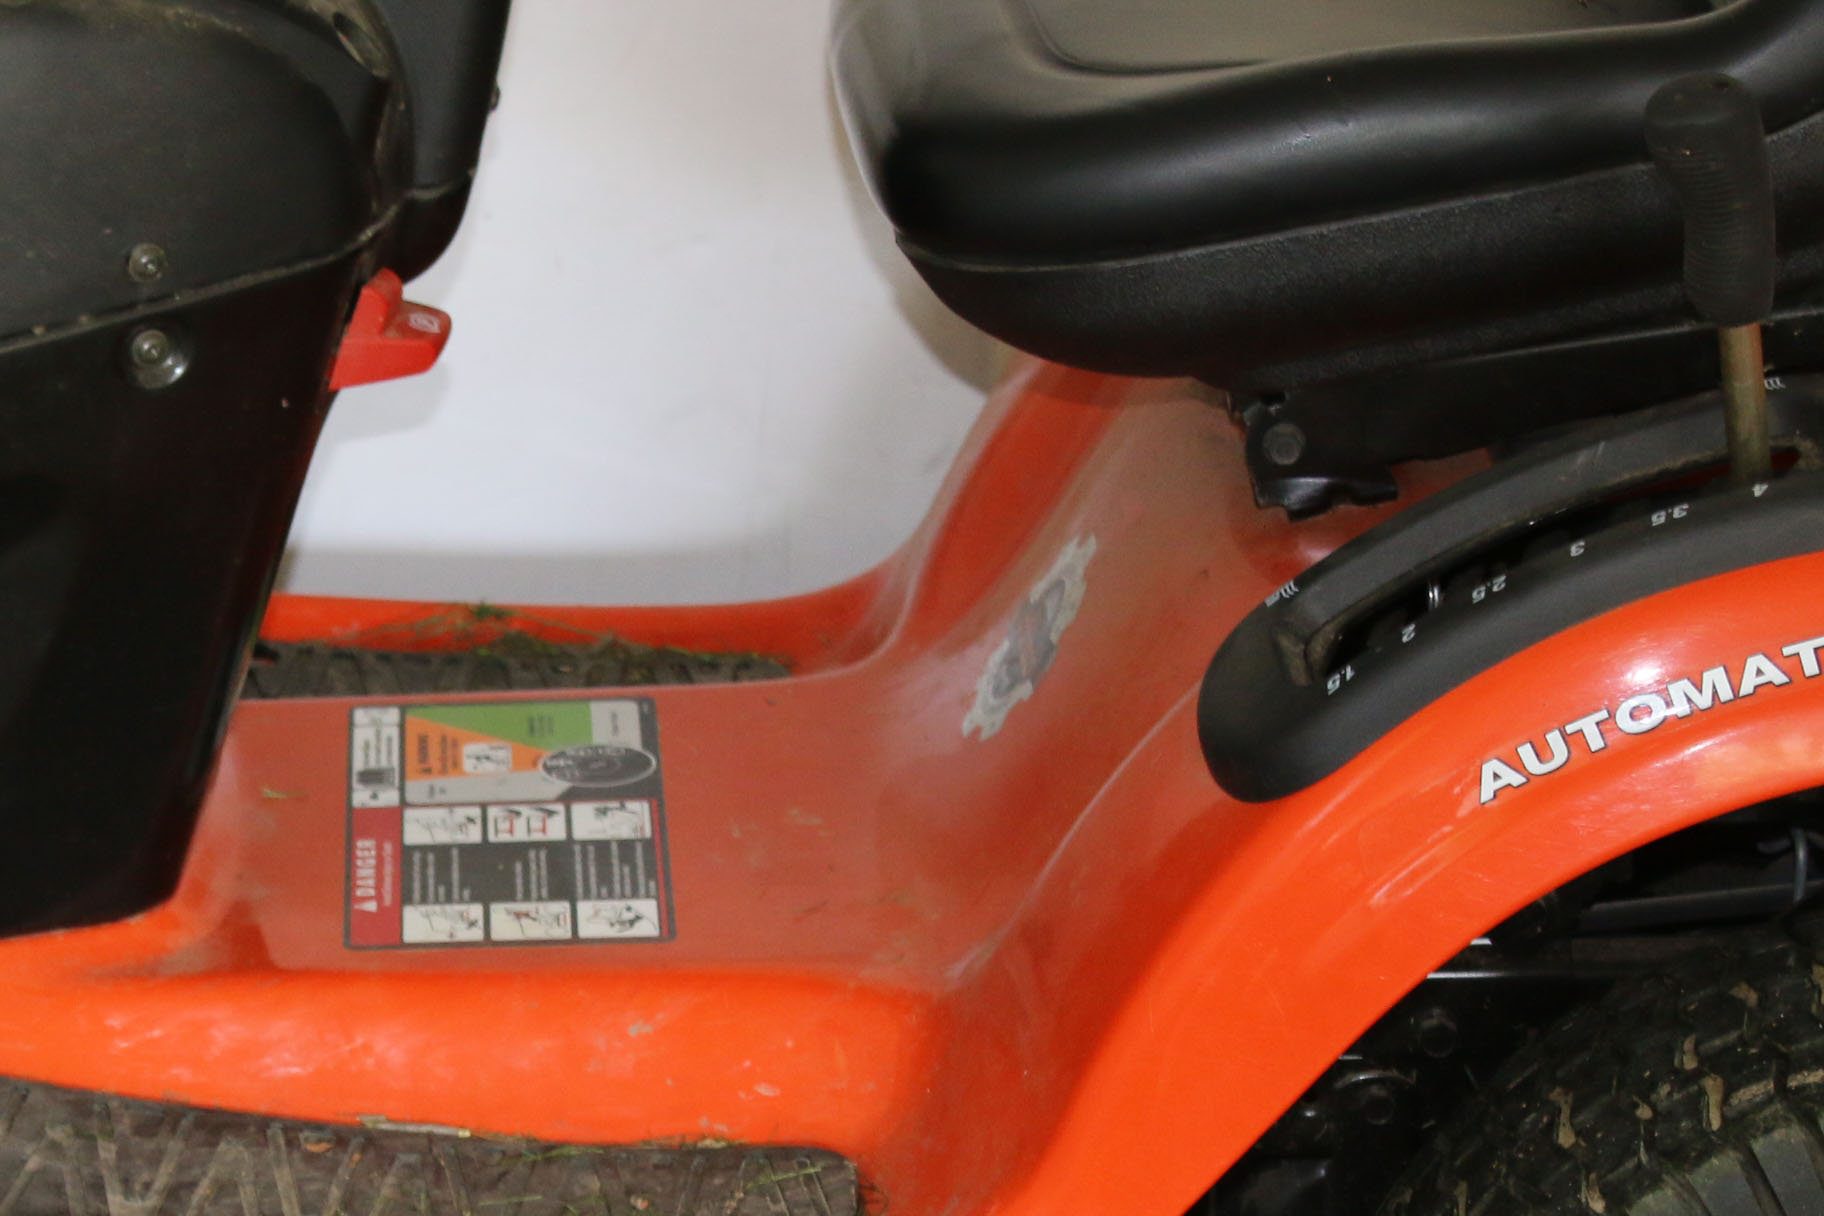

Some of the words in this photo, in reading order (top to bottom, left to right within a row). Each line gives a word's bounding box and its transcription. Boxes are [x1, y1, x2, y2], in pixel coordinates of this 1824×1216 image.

[1751, 482, 1769, 498] 4
[1650, 503, 1690, 527] 3.5
[1569, 540, 1586, 558] 3
[1471, 574, 1507, 604] 2.5
[1401, 623, 1416, 643] 2
[1326, 664, 1355, 696] 1.5
[355, 839, 377, 898] DANGER
